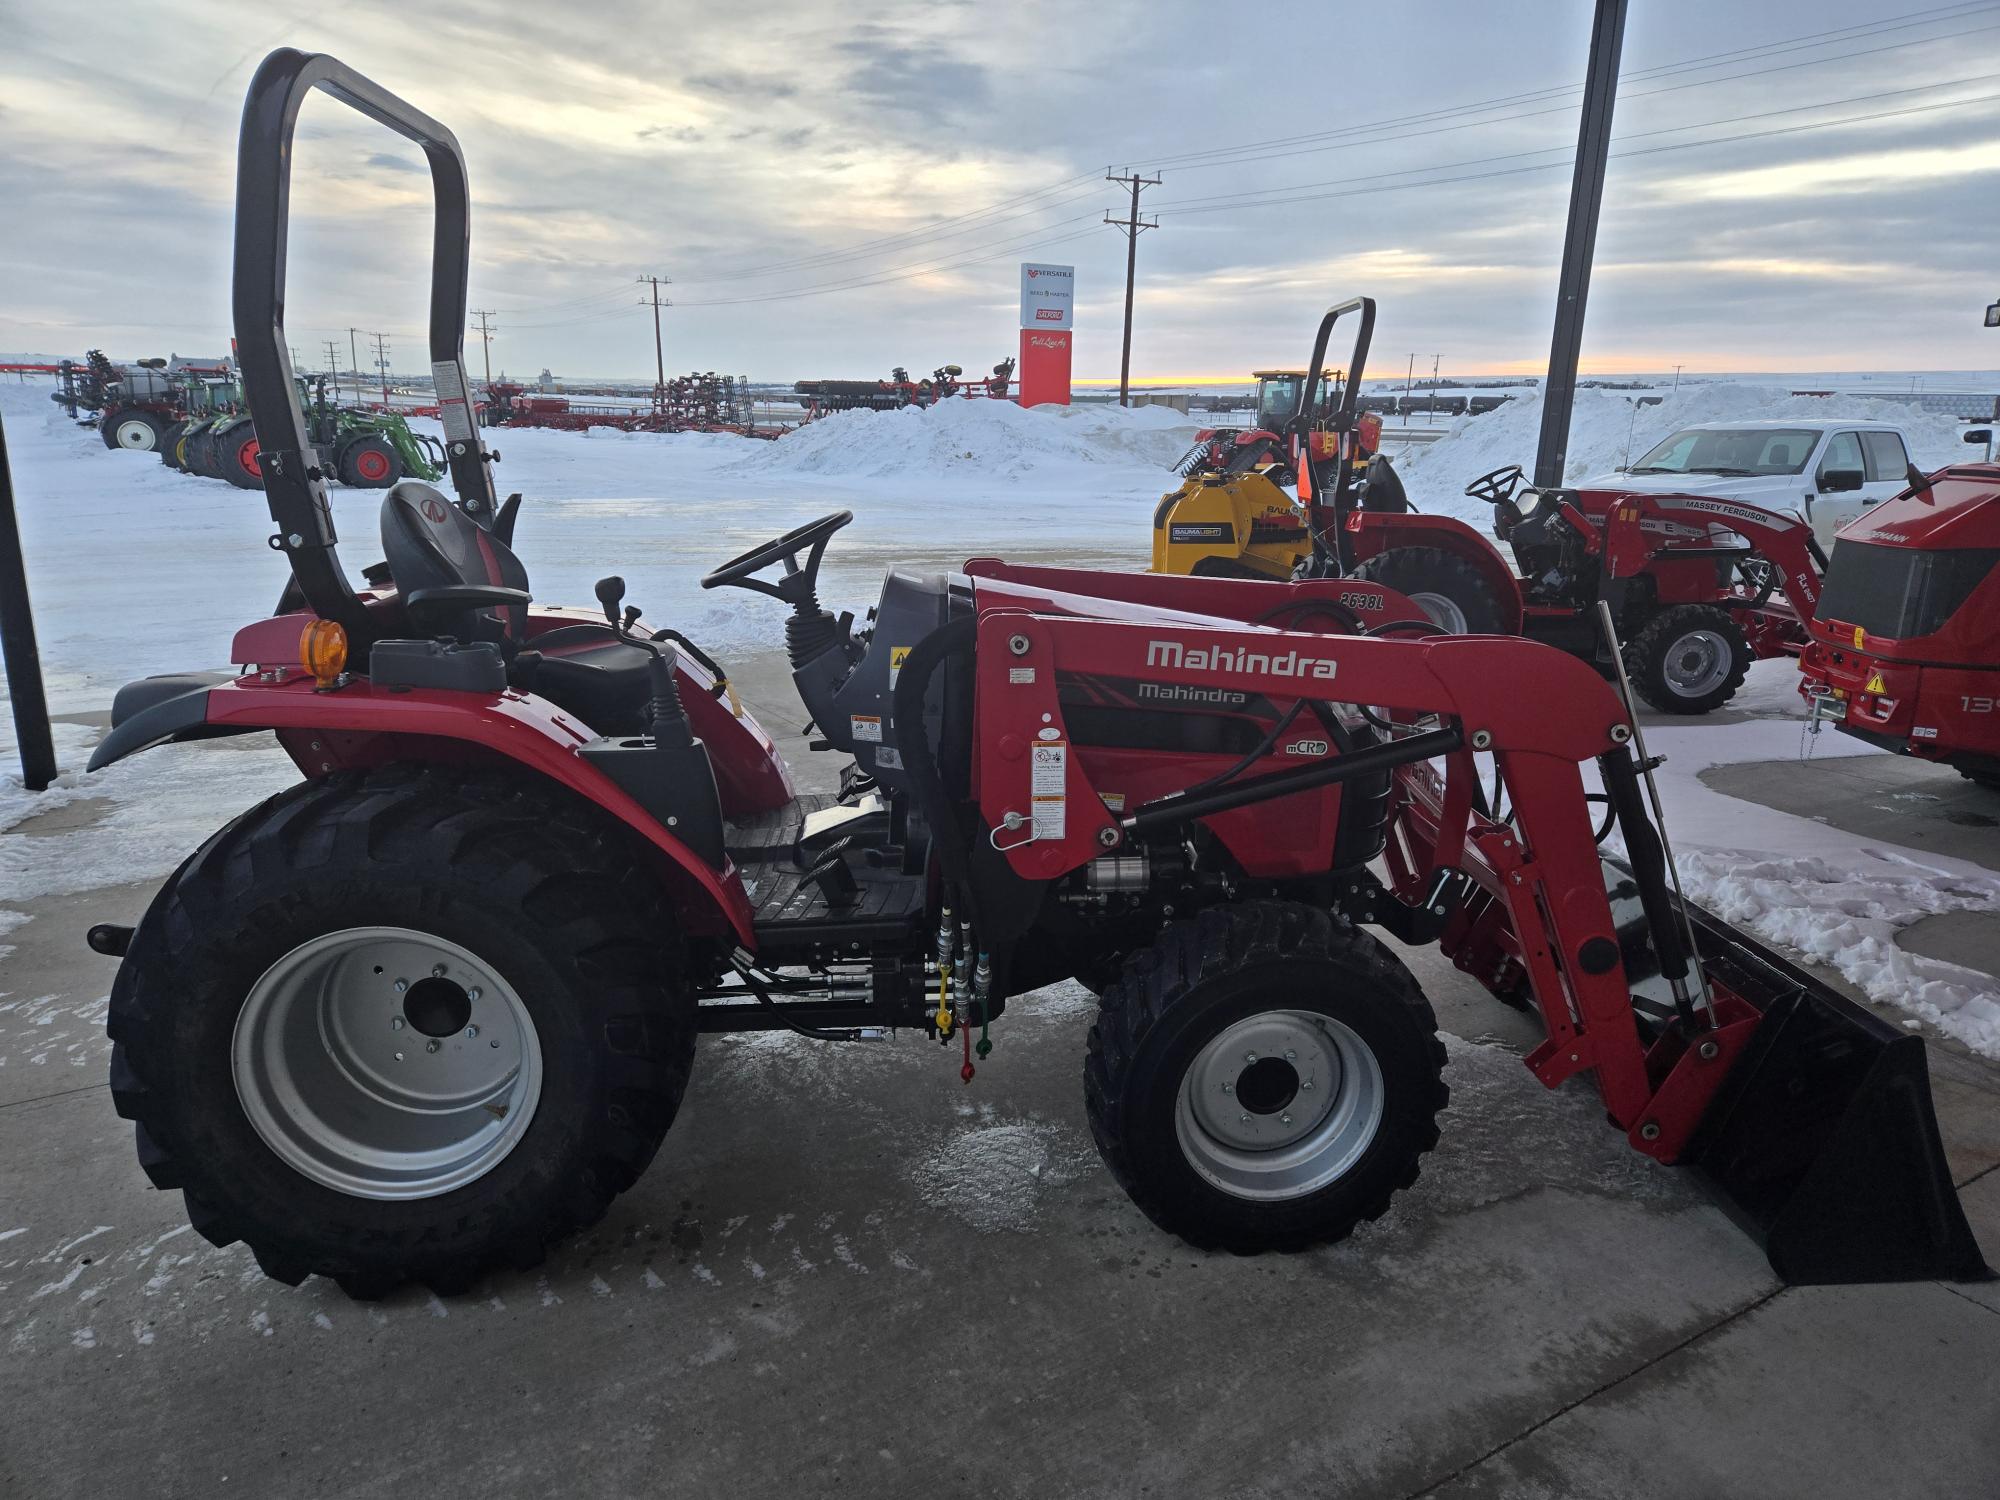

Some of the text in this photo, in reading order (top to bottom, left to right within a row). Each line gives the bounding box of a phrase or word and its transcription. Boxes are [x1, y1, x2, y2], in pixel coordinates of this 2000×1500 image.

[1038, 270, 1073, 278] VERSATILE
[1686, 500, 1769, 523] MASSEY FERGUSON
[1340, 592, 1384, 611] 2638L
[1146, 640, 1338, 680] Mahindra
[1138, 683, 1246, 704] Mahindra
[1960, 696, 2000, 713] 13
[1287, 741, 1327, 754] mCRD
